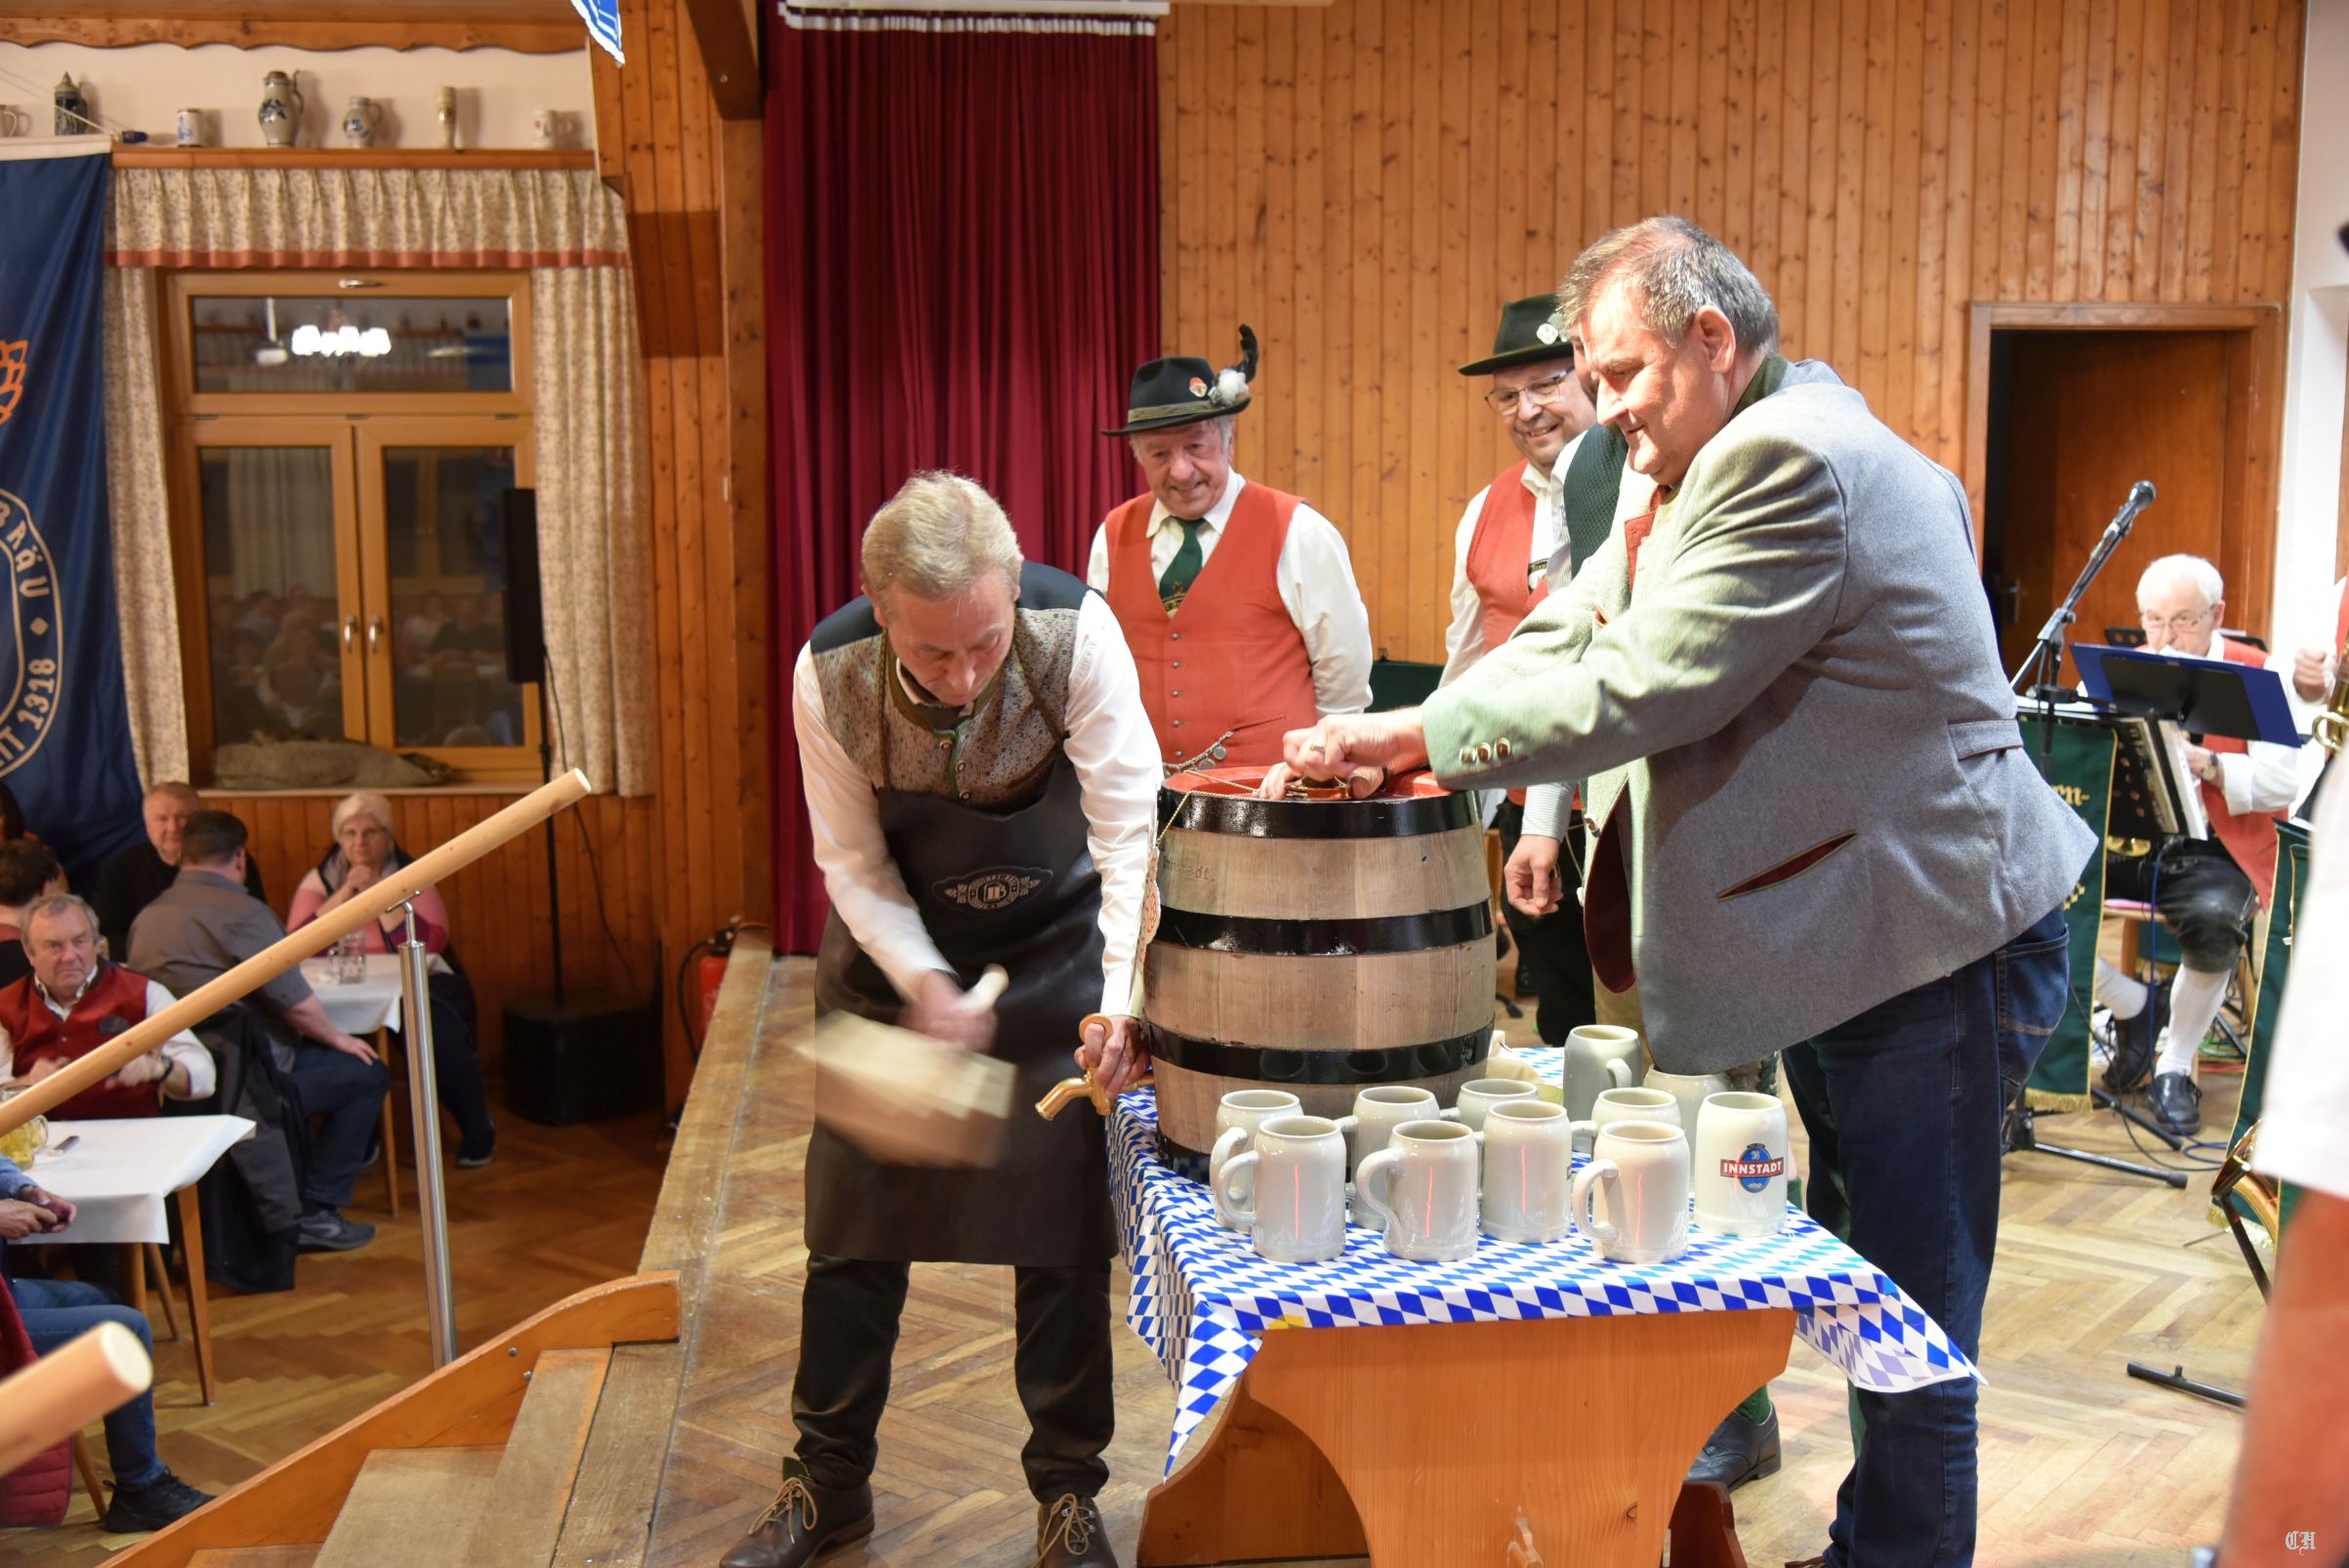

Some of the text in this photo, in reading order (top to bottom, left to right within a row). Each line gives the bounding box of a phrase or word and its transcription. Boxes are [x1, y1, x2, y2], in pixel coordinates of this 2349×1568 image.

[0, 658, 56, 766] IT 1318
[1723, 1161, 1782, 1175] INNSTADT
